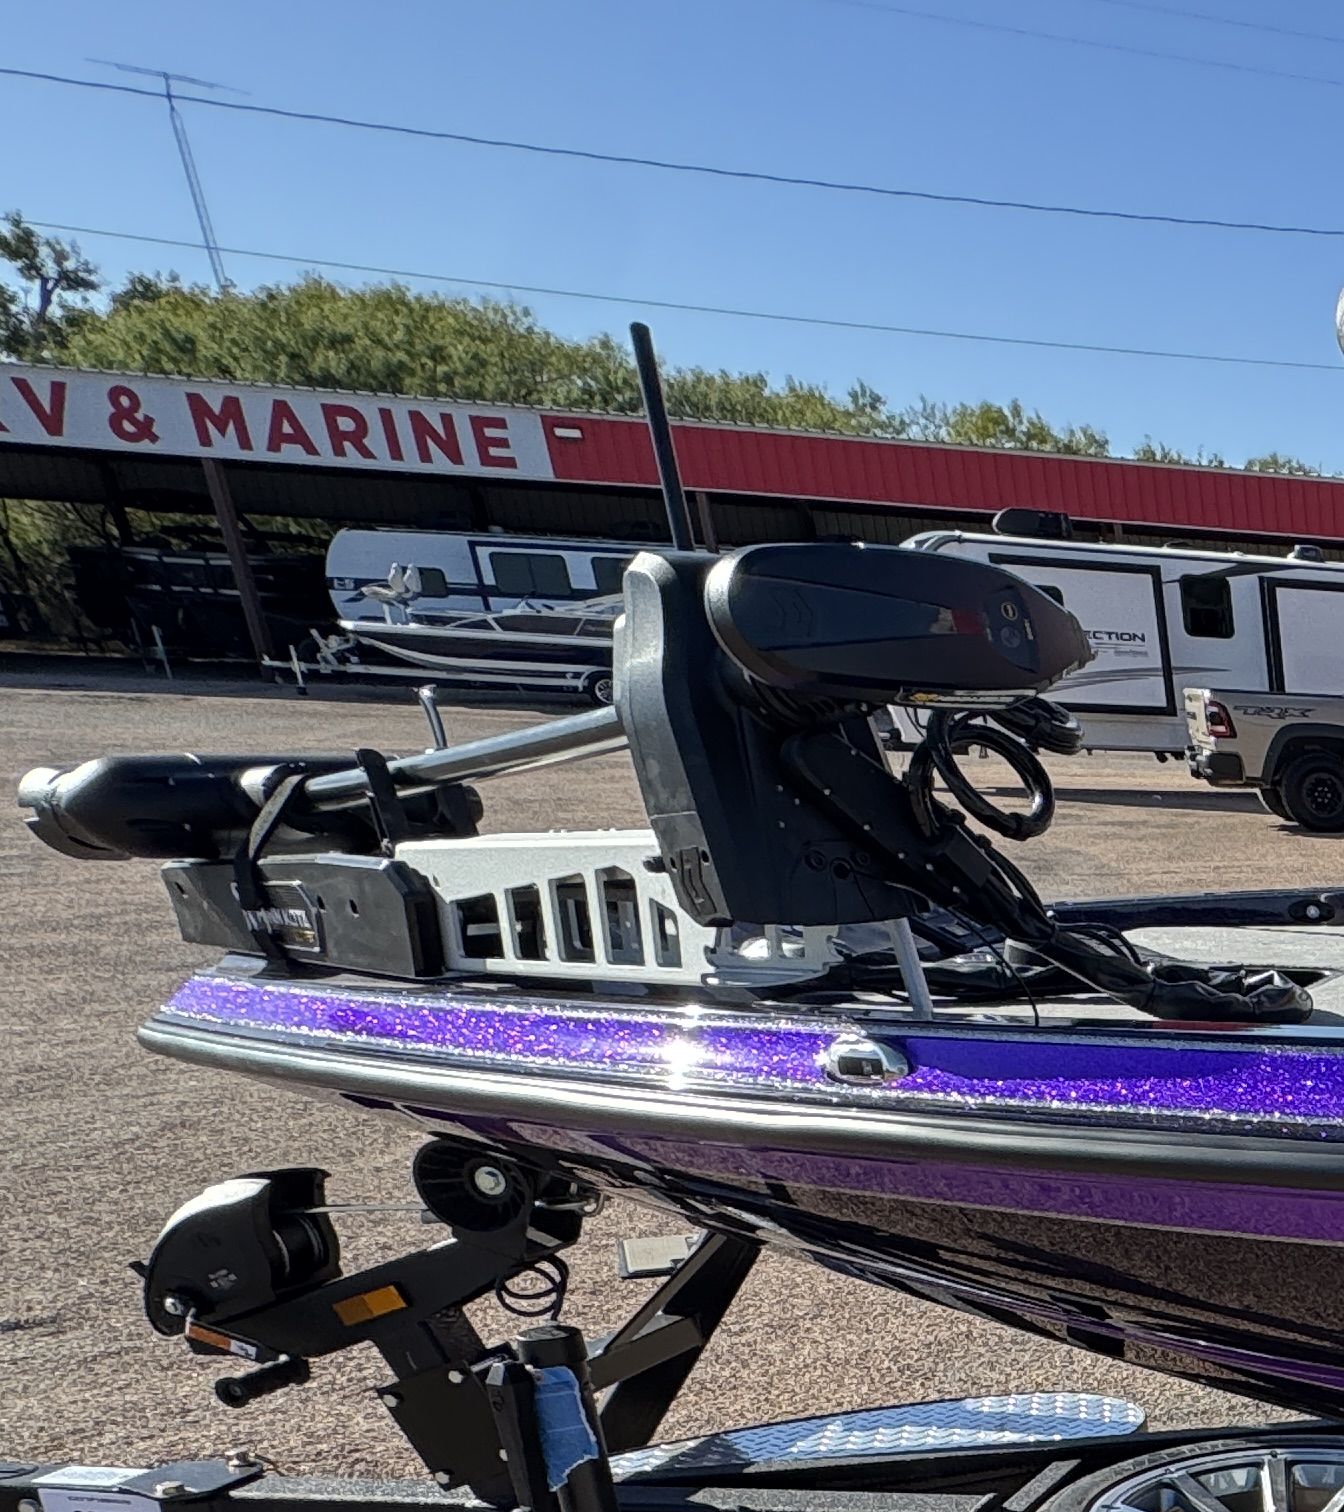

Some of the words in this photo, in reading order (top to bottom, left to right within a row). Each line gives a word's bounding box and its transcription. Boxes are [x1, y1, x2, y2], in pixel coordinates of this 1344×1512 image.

[0, 376, 67, 437] V
[106, 384, 160, 445] &
[185, 391, 518, 470] MARINE
[1082, 630, 1146, 643] ECTION
